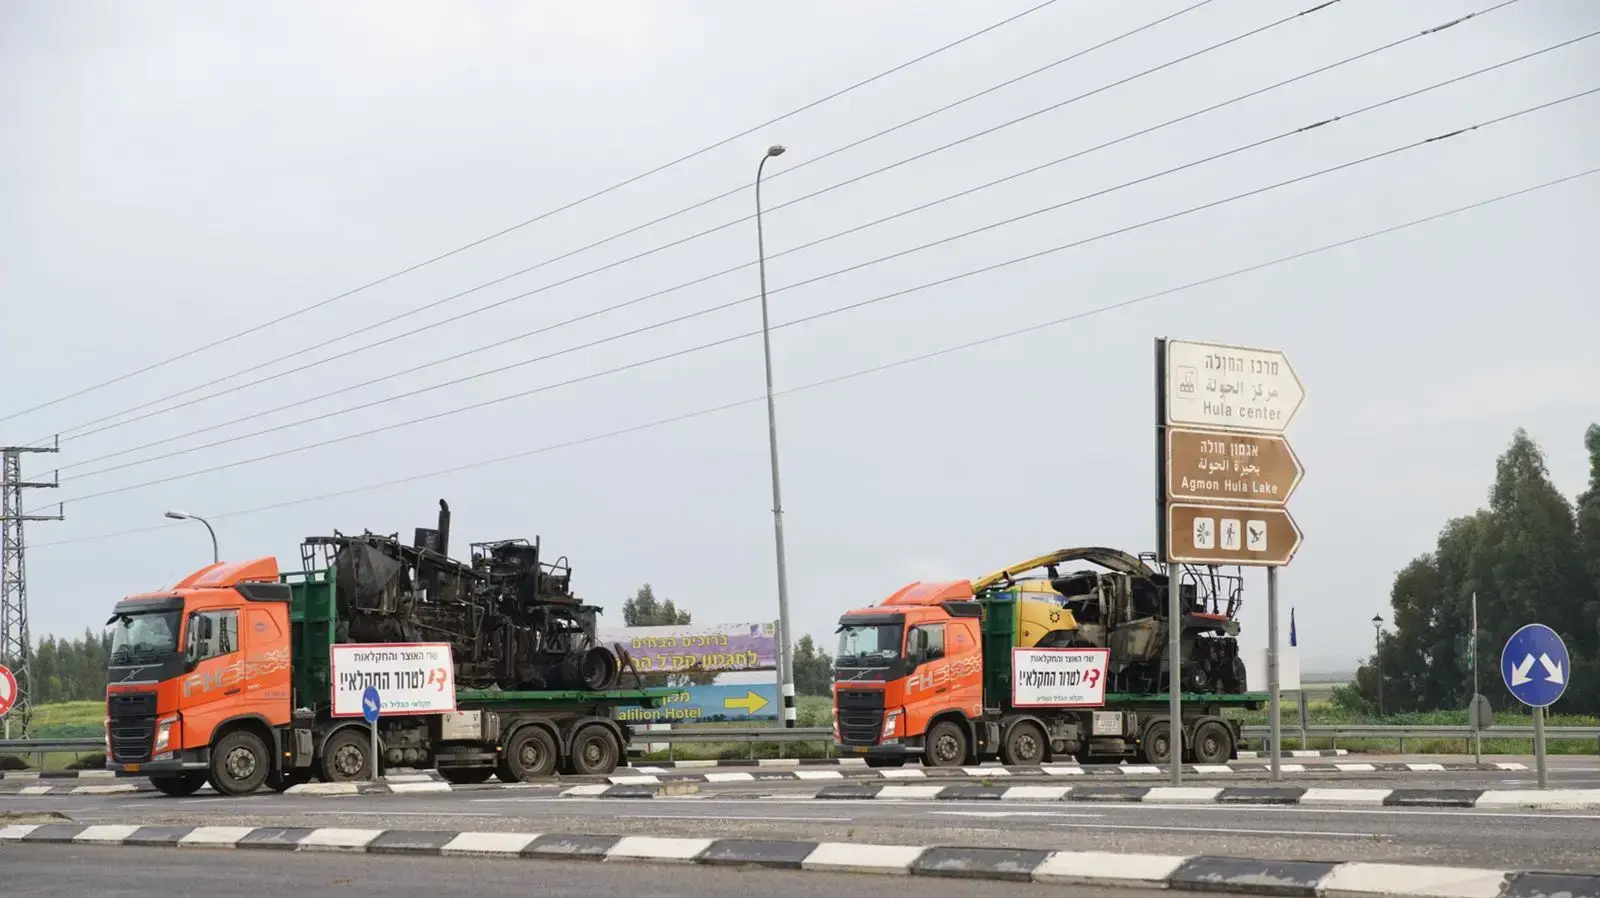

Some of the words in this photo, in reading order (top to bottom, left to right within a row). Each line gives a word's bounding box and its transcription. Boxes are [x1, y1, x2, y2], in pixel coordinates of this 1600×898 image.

[1205, 353, 1244, 372] החולה
[1251, 359, 1279, 376] מרכז
[1206, 378, 1244, 398] الحولة
[1252, 383, 1278, 402] مركز
[1203, 401, 1232, 417] Hula
[1239, 406, 1281, 420] center
[1200, 440, 1225, 454] חולה
[1230, 443, 1259, 457] אגמון
[1198, 457, 1229, 474] الحولة
[1234, 460, 1260, 476] بحيرة
[1181, 476, 1219, 491] Agmon
[1224, 479, 1248, 492] Hula
[1252, 481, 1278, 494] Lake
[681, 634, 728, 648] ברוכים
[354, 650, 398, 663] והחקלאות
[400, 651, 424, 661] האוצר
[426, 651, 438, 660] שרי
[1083, 655, 1095, 663] שרי
[394, 669, 425, 690] לטרור
[905, 671, 934, 695] FH
[1019, 669, 1056, 688] החקלאי!
[1059, 669, 1080, 687] לטרור
[618, 709, 660, 721] alilion
[665, 707, 702, 719] Hotel
